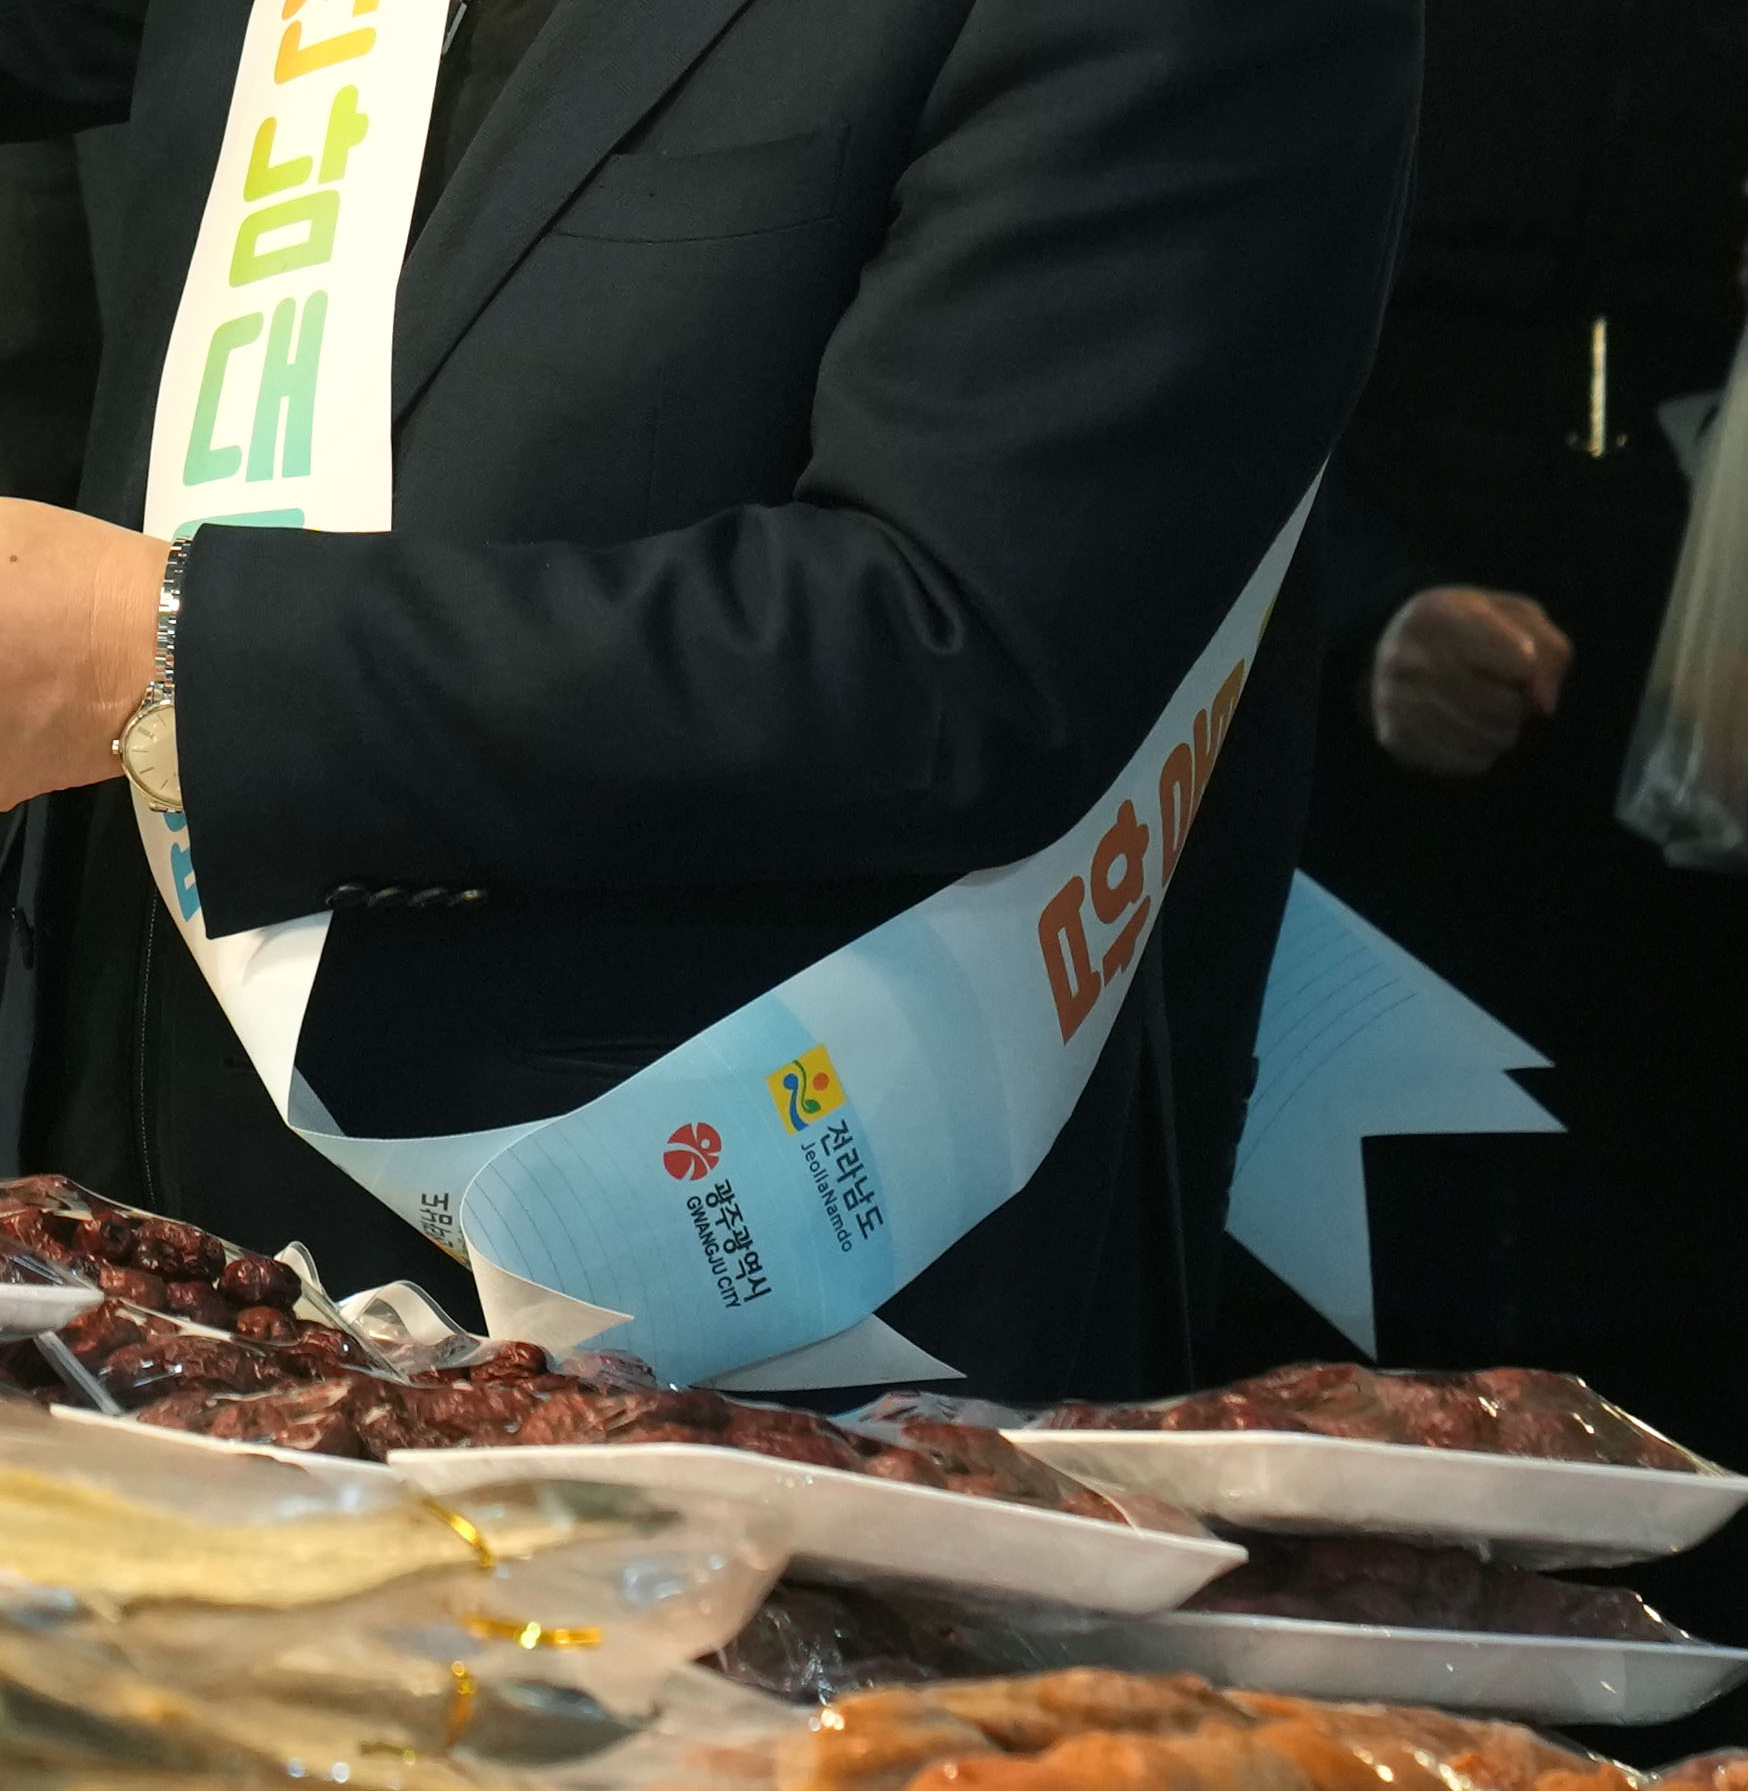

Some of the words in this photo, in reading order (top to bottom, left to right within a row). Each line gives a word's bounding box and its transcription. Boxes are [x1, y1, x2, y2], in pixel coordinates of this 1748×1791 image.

[800, 1141, 853, 1253] JeollaNamdo
[819, 1118, 884, 1240] 전라남도
[686, 1195, 726, 1276] GWANGJU
[717, 1275, 742, 1309] CITY
[705, 1178, 772, 1303] 광주광역시
